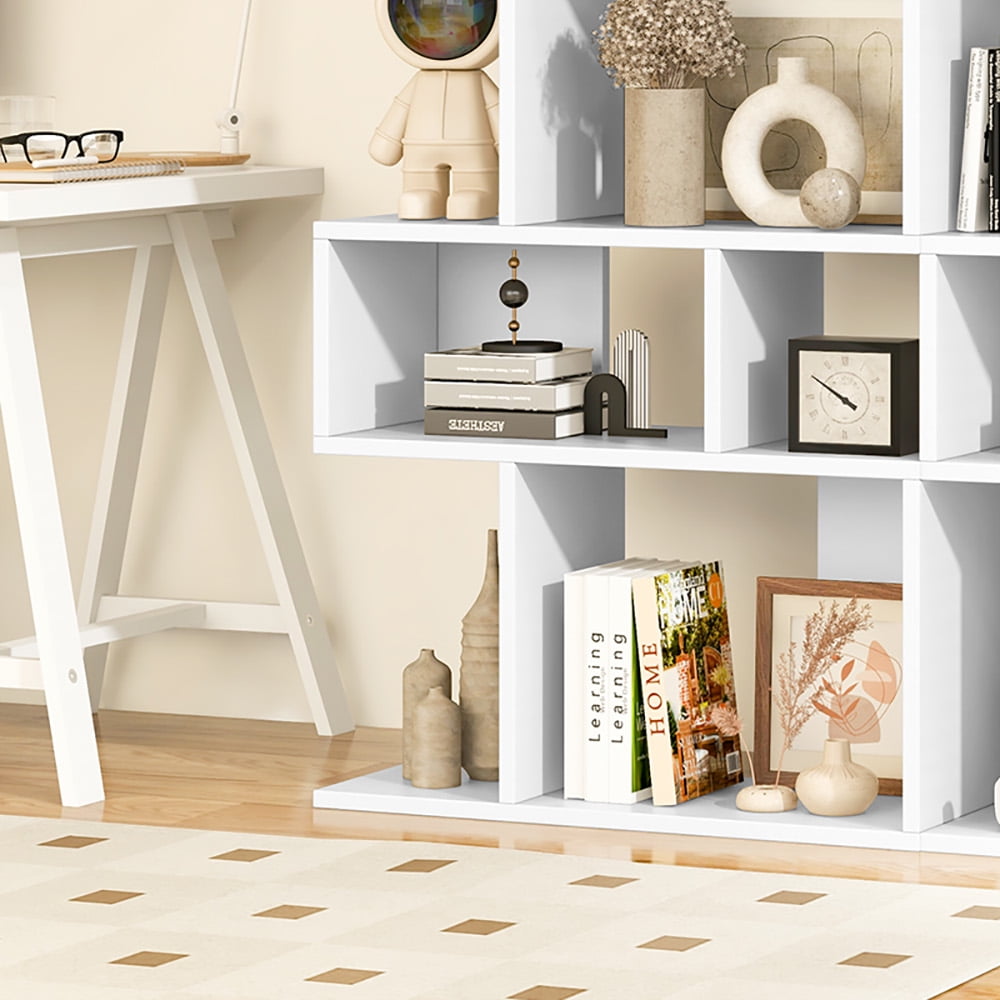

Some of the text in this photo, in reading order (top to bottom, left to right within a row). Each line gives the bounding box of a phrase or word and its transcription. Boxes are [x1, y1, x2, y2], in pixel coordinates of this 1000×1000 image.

[448, 419, 505, 432] AESTHETE
[588, 632, 604, 742] Learning
[611, 634, 627, 744] Learning
[642, 643, 665, 736] HOME
